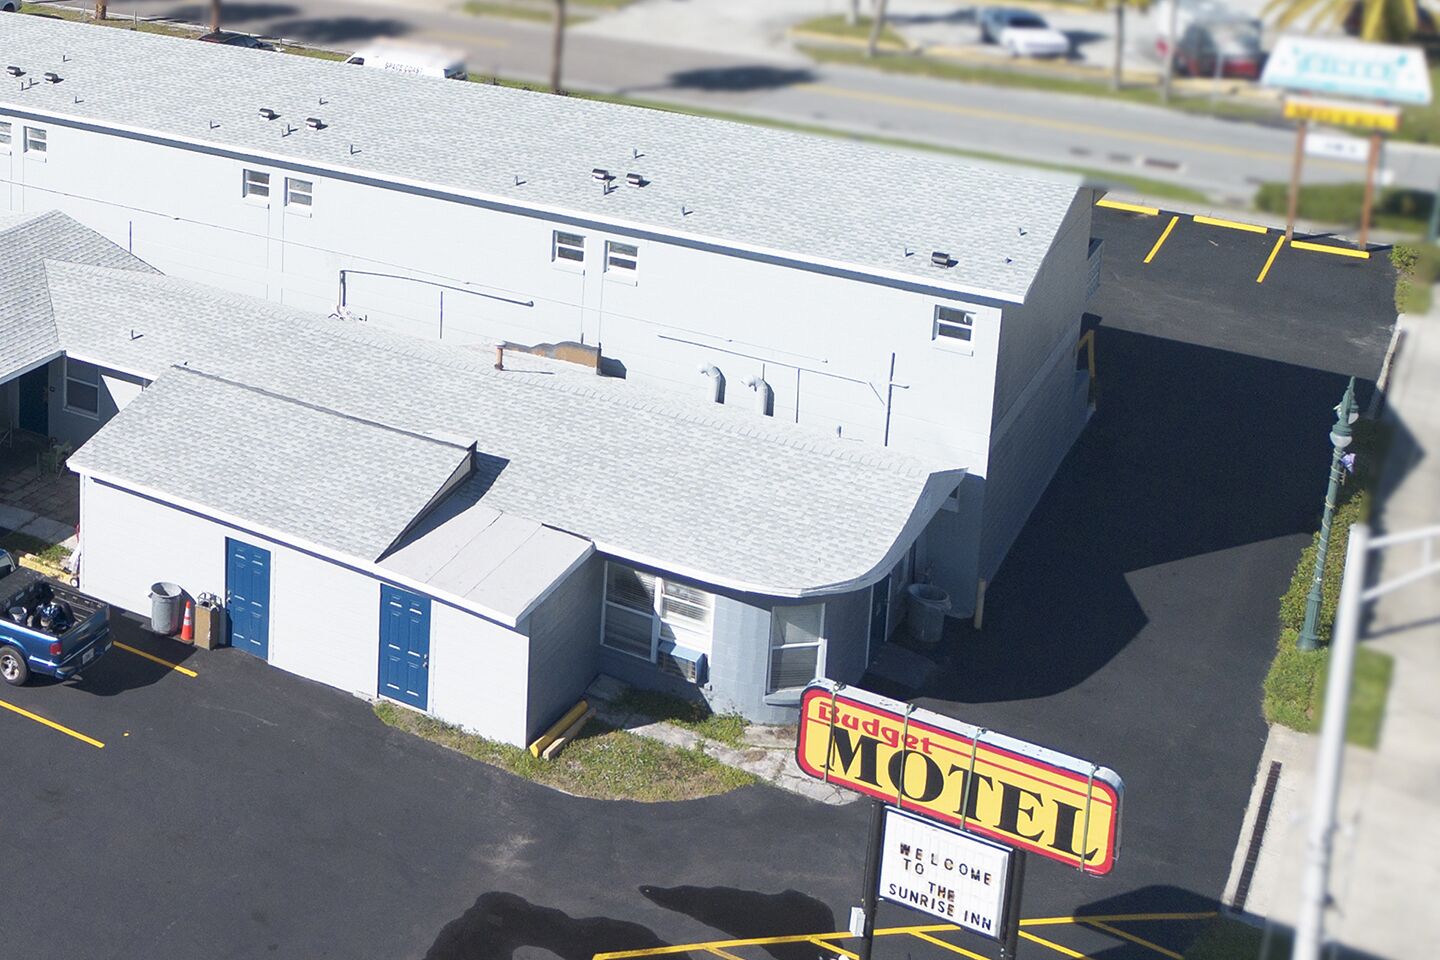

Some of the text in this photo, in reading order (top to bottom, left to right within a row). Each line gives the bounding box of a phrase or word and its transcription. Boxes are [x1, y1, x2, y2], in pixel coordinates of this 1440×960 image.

[819, 701, 933, 755] Budget
[819, 726, 1099, 862] MOTEL
[900, 843, 992, 886] WELCOME
[903, 858, 924, 875] TO
[889, 883, 992, 931] SUNRISE INN
[928, 881, 955, 902] THE
